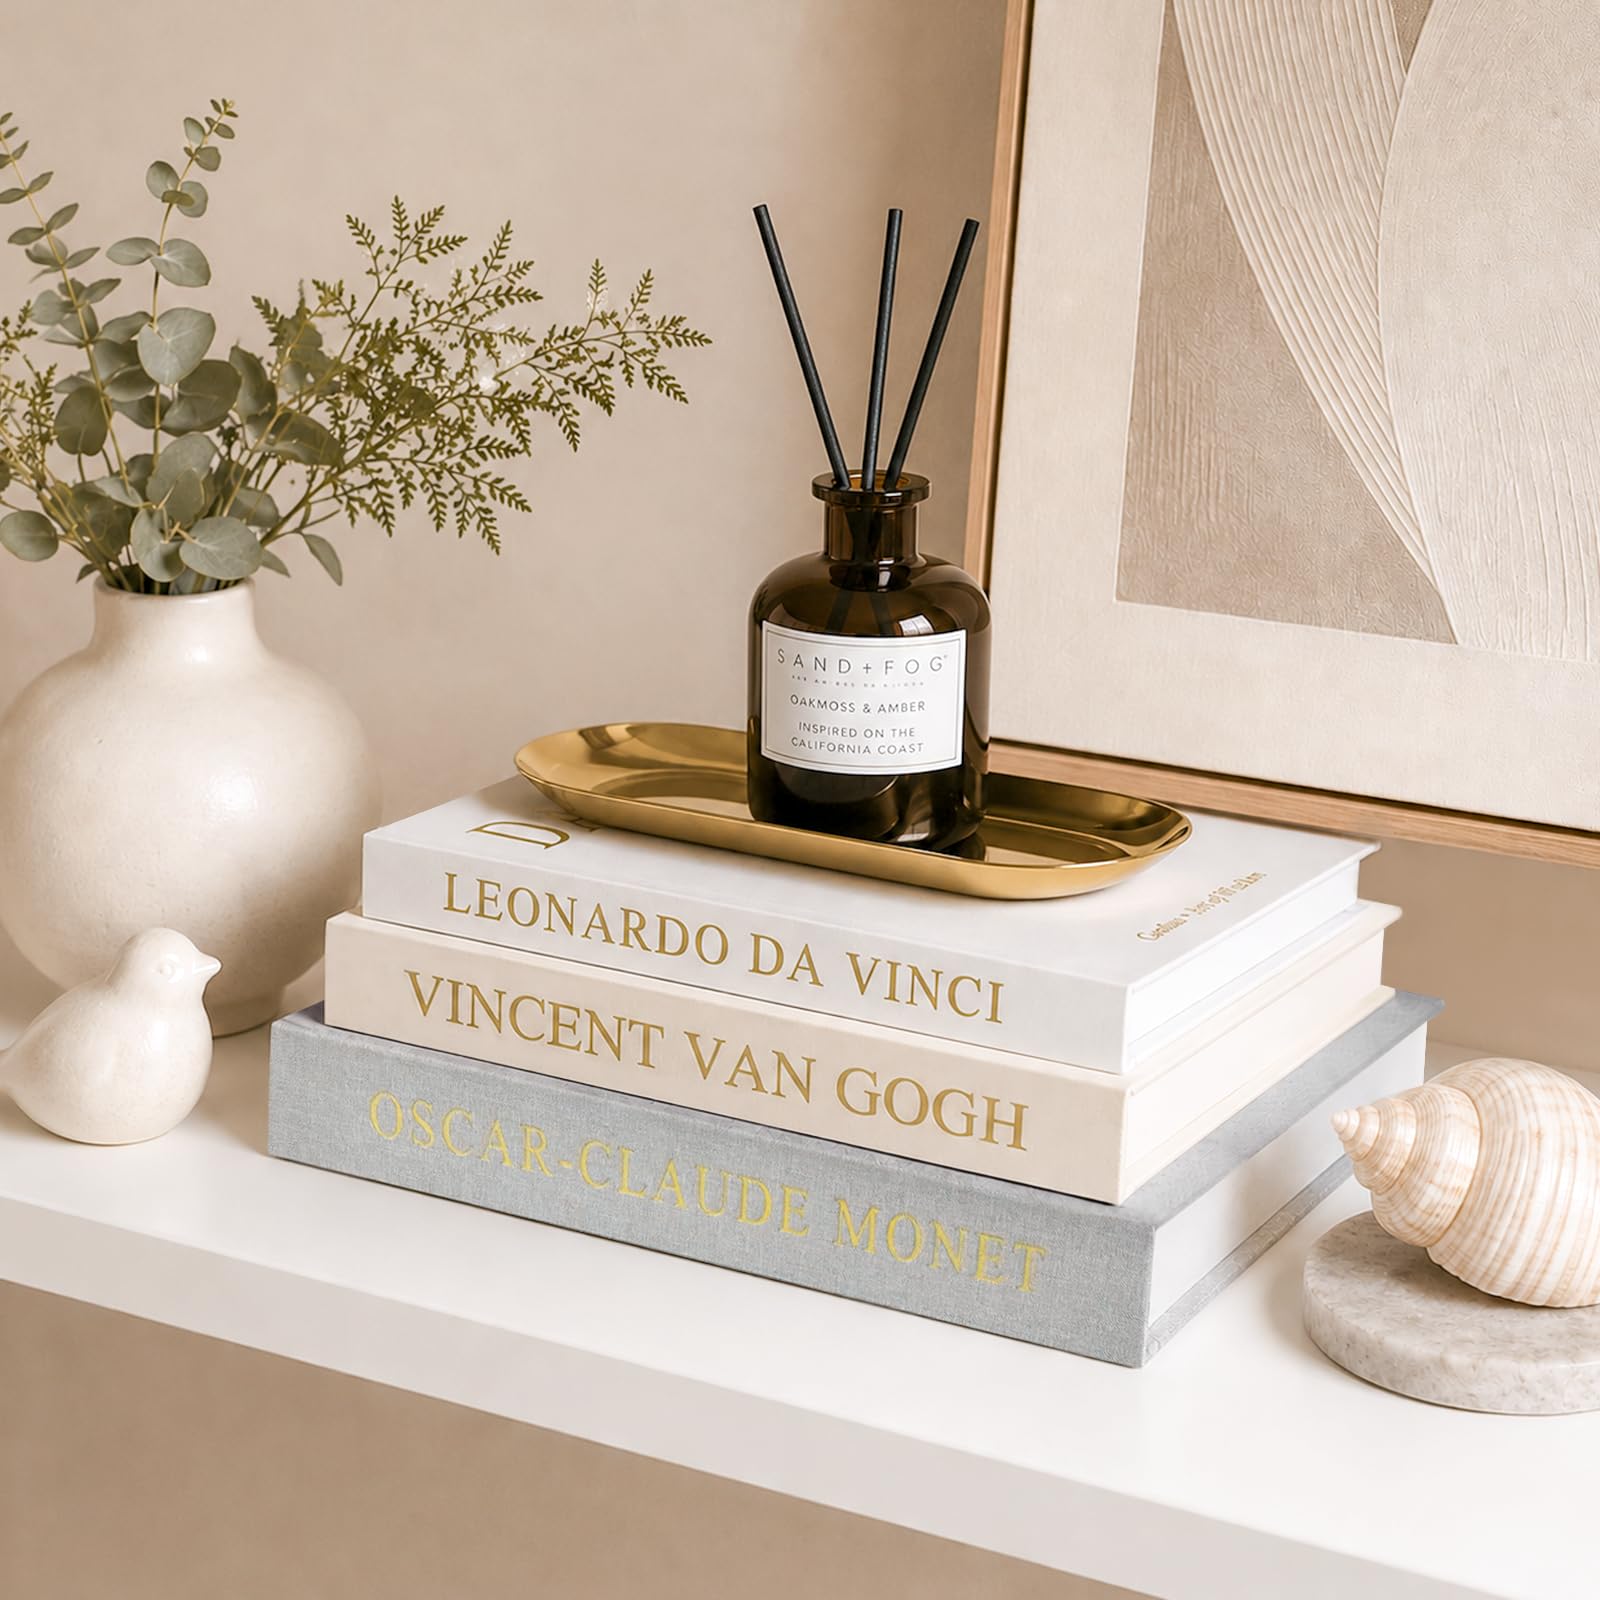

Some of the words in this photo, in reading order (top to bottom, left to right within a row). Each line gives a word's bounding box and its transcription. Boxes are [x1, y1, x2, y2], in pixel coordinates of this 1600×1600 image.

[790, 694, 856, 713] OAKMOSS
[862, 703, 872, 714] &
[877, 701, 926, 714] AMBER
[791, 736, 871, 755] CALIFORNIA
[877, 742, 925, 755] COAST
[798, 721, 858, 738] INSPIRED
[863, 728, 885, 739] ON
[892, 727, 915, 738] THE
[443, 872, 730, 966] LEONARDO
[748, 932, 825, 988] DA
[845, 952, 1005, 1025] VINCI
[404, 969, 665, 1069] VINCENT
[684, 1031, 816, 1103] VAN
[836, 1066, 1029, 1152] GOGH
[369, 1090, 809, 1237] OSCAR-CLAUDE
[833, 1199, 1047, 1294] MONET
